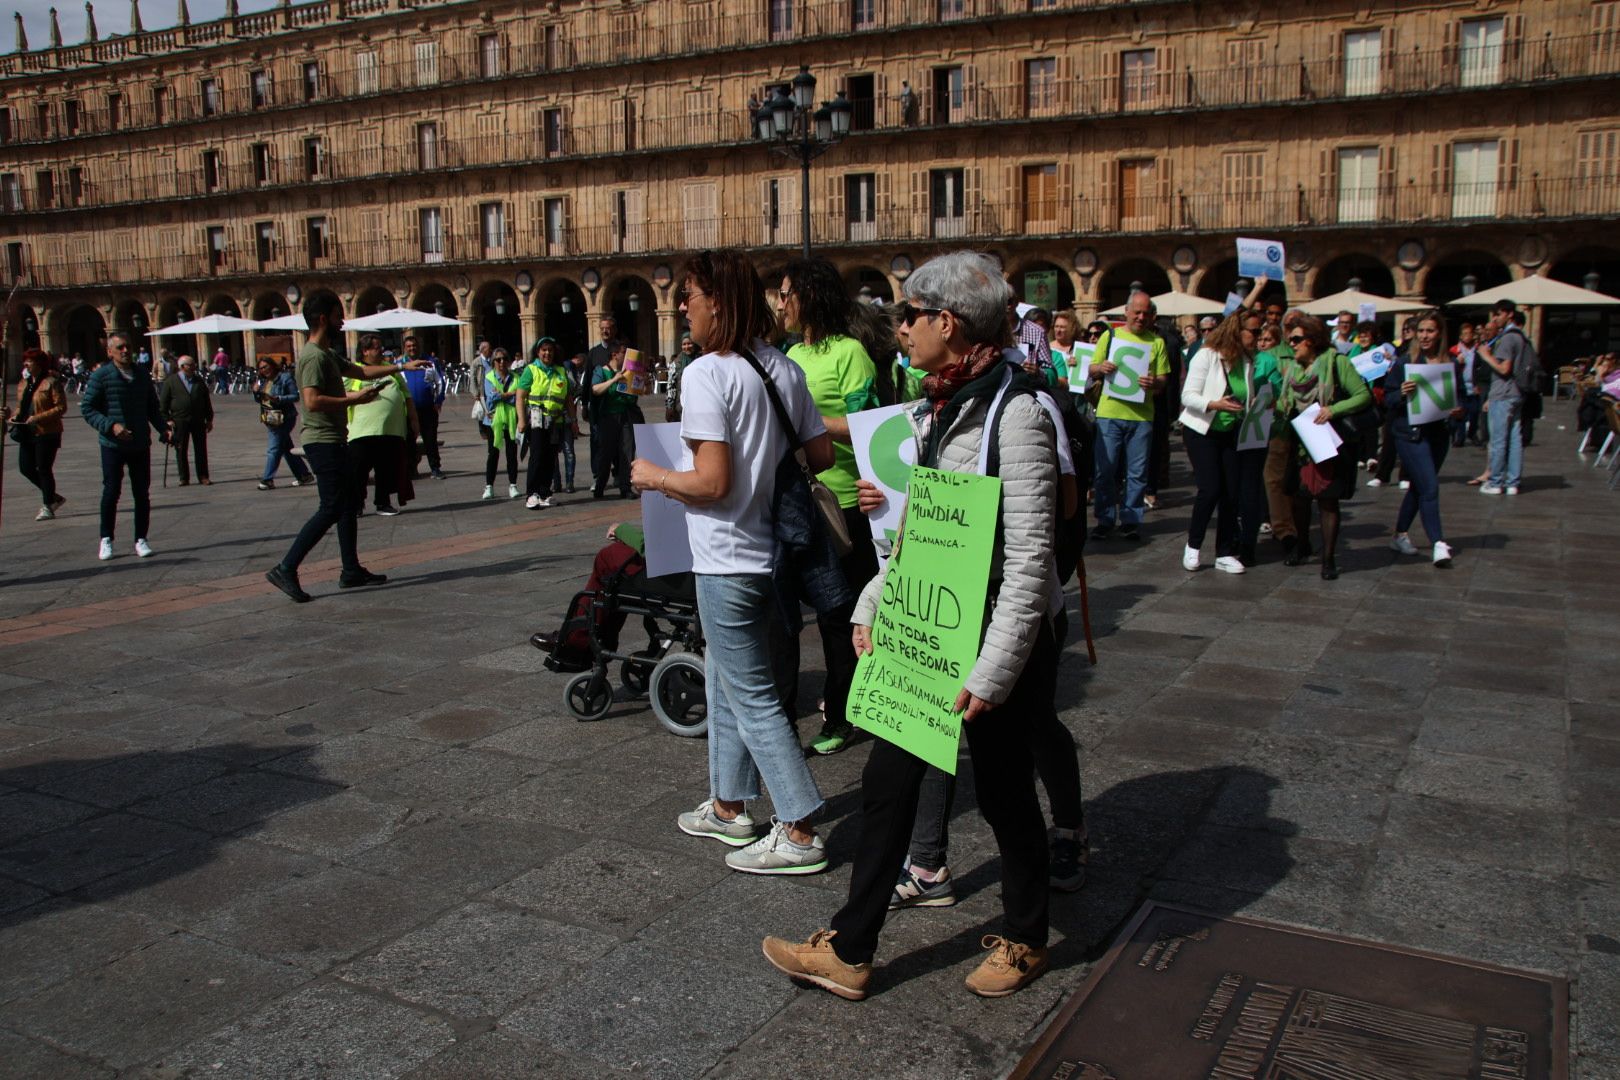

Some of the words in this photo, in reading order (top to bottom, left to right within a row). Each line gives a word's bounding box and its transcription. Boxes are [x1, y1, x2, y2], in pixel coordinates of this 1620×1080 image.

[1109, 346, 1145, 396] S
[1409, 371, 1455, 414] N
[912, 503, 970, 527] MUNDIAL
[883, 568, 961, 630] SALUD
[877, 628, 895, 653] LAS
[899, 640, 961, 679] PERSONAS
[879, 611, 895, 631] PARA
[899, 623, 940, 651] TODAS
